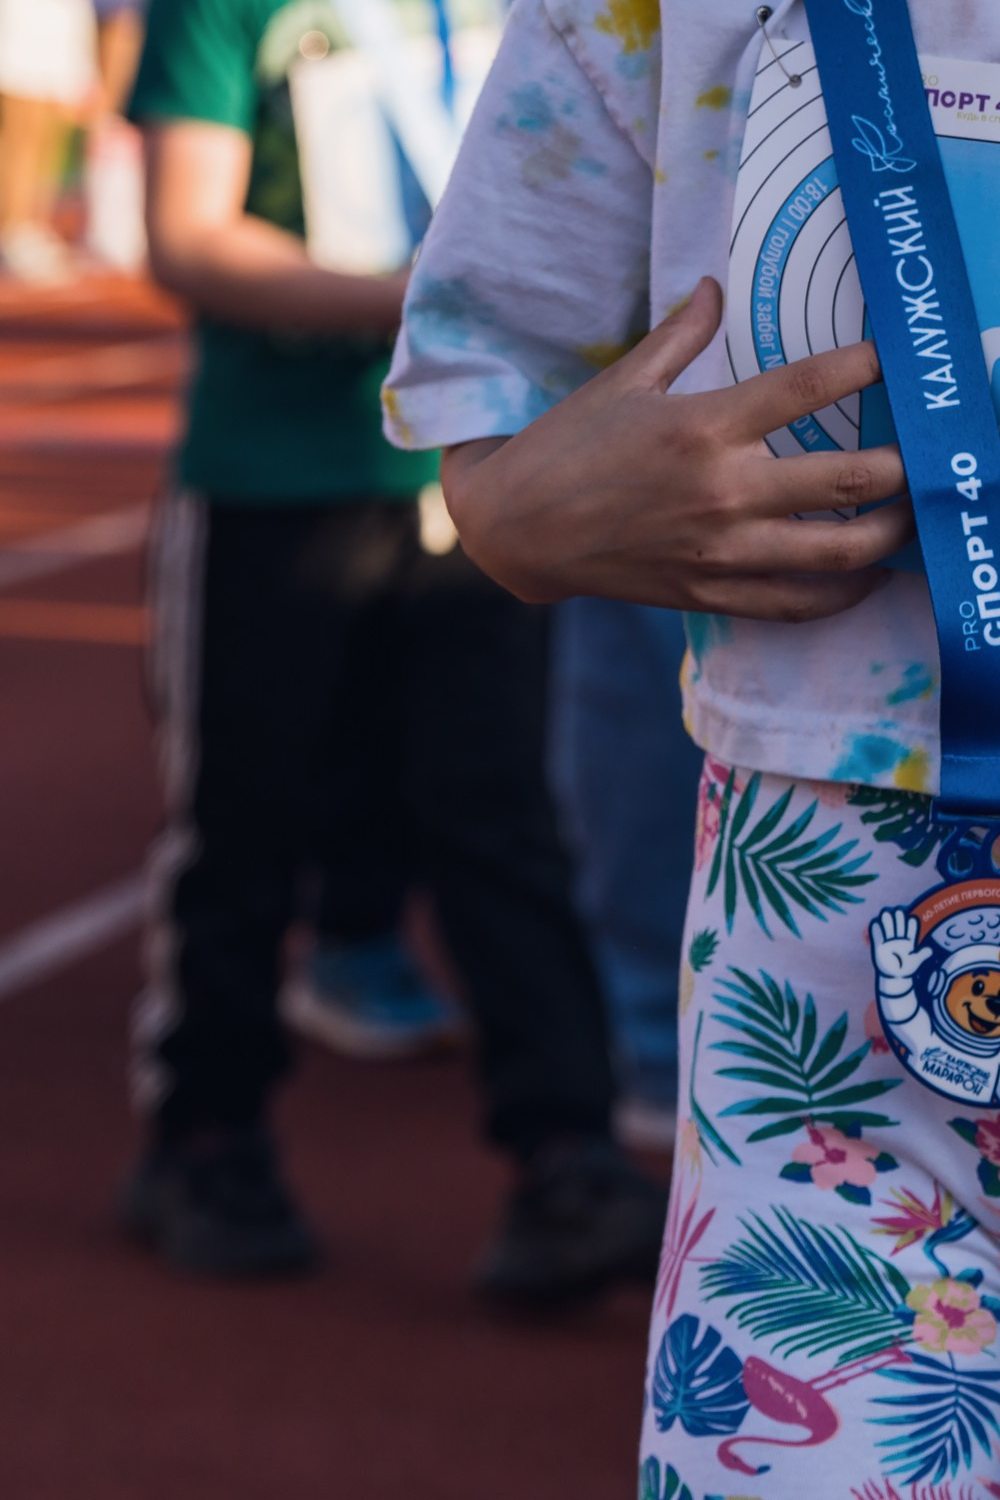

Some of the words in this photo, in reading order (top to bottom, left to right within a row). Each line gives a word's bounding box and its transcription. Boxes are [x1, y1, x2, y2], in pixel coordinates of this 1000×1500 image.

[924, 88, 991, 112] ПОРТ
[788, 177, 828, 221] 18:00
[758, 227, 790, 299] голубой
[874, 186, 960, 410] КАЛУЖСКИЙ
[756, 302, 777, 351] забег
[951, 452, 983, 501] 40
[959, 601, 981, 652] PRO
[922, 1060, 984, 1097] МАРАФОН
